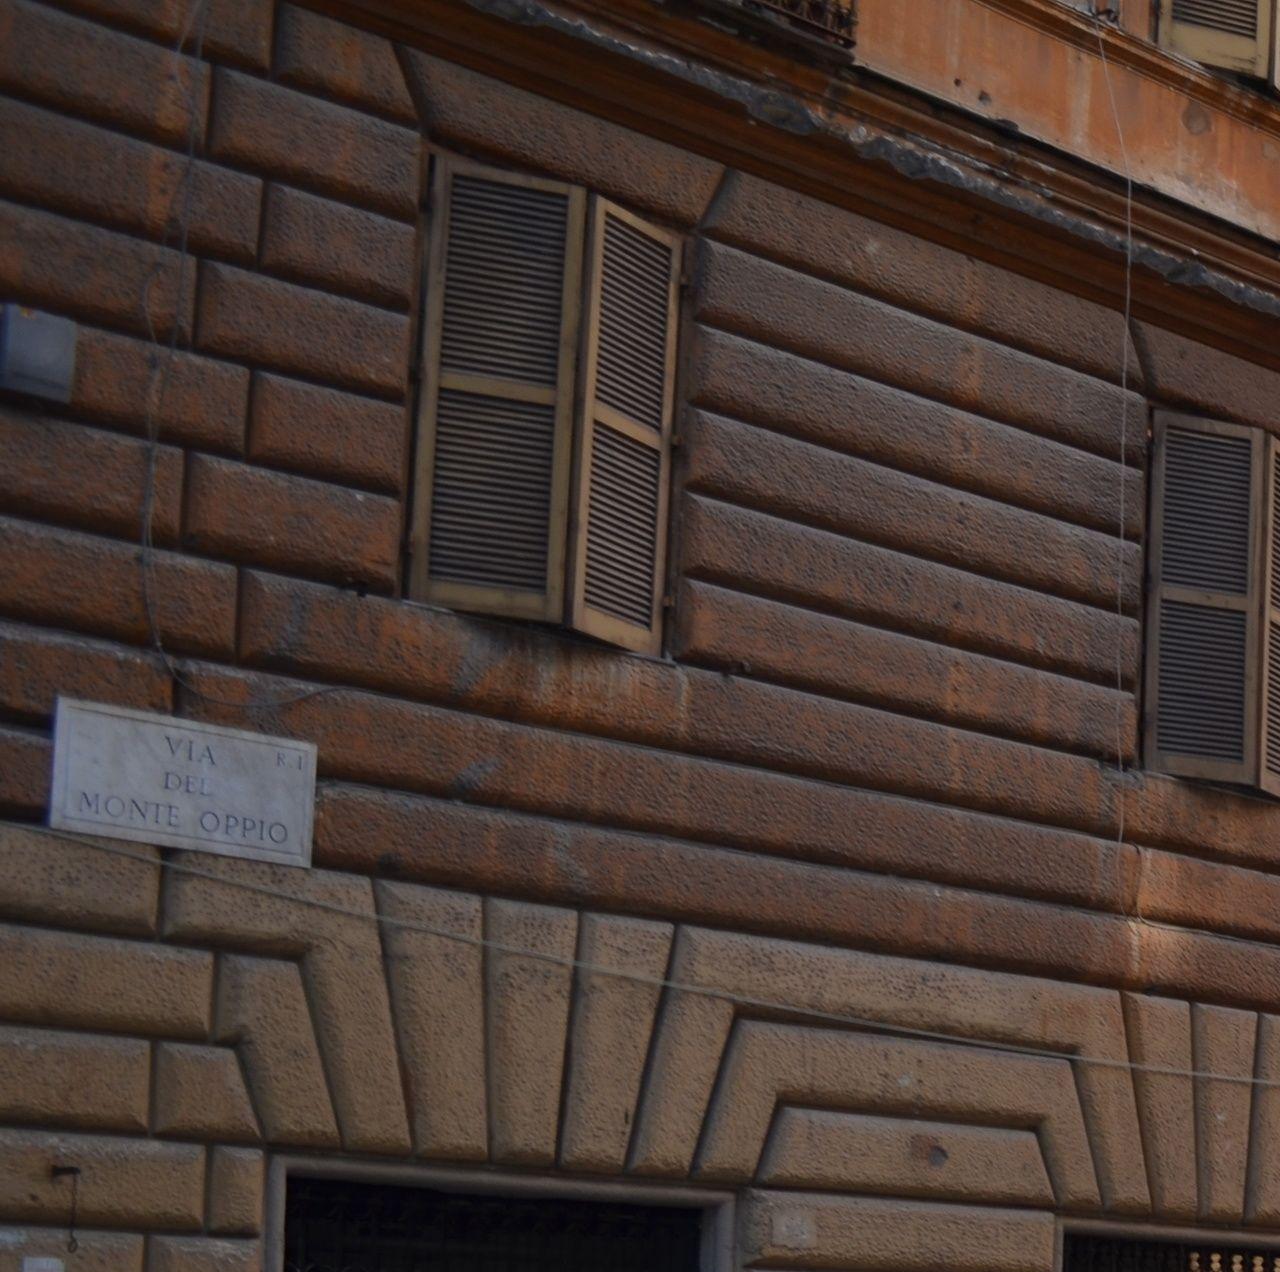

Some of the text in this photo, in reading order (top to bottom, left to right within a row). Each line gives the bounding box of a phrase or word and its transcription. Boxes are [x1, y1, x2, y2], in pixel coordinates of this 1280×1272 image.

[164, 735, 217, 767] VIA
[163, 771, 213, 797] DEL
[79, 791, 289, 844] MONTE OPPIO
